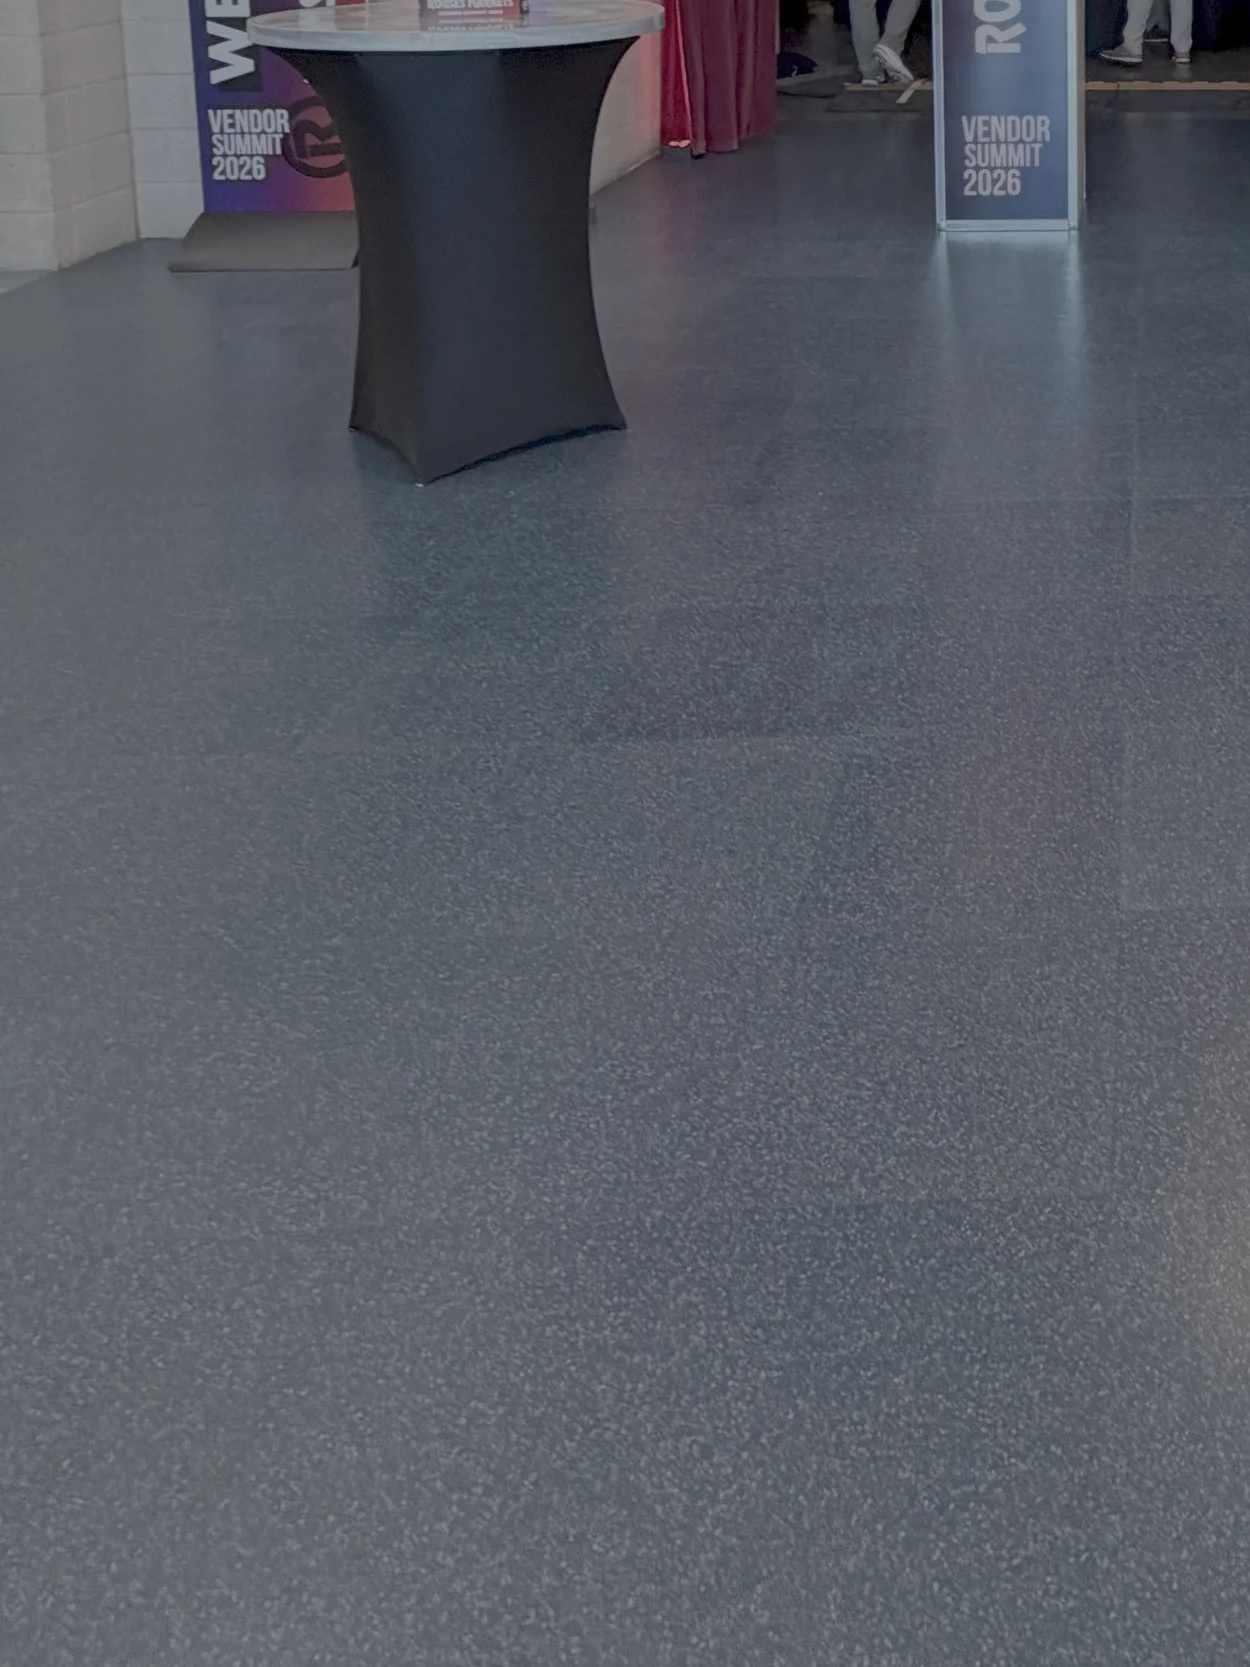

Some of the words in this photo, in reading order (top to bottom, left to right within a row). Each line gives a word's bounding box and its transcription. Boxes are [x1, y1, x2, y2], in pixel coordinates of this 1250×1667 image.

[208, 109, 290, 133] VENDOR
[961, 115, 1051, 143] VENDOR
[212, 134, 284, 156] SUMMIT
[963, 142, 1043, 168] SUMMIT
[212, 156, 267, 181] 2026
[963, 168, 1021, 197] 2026
